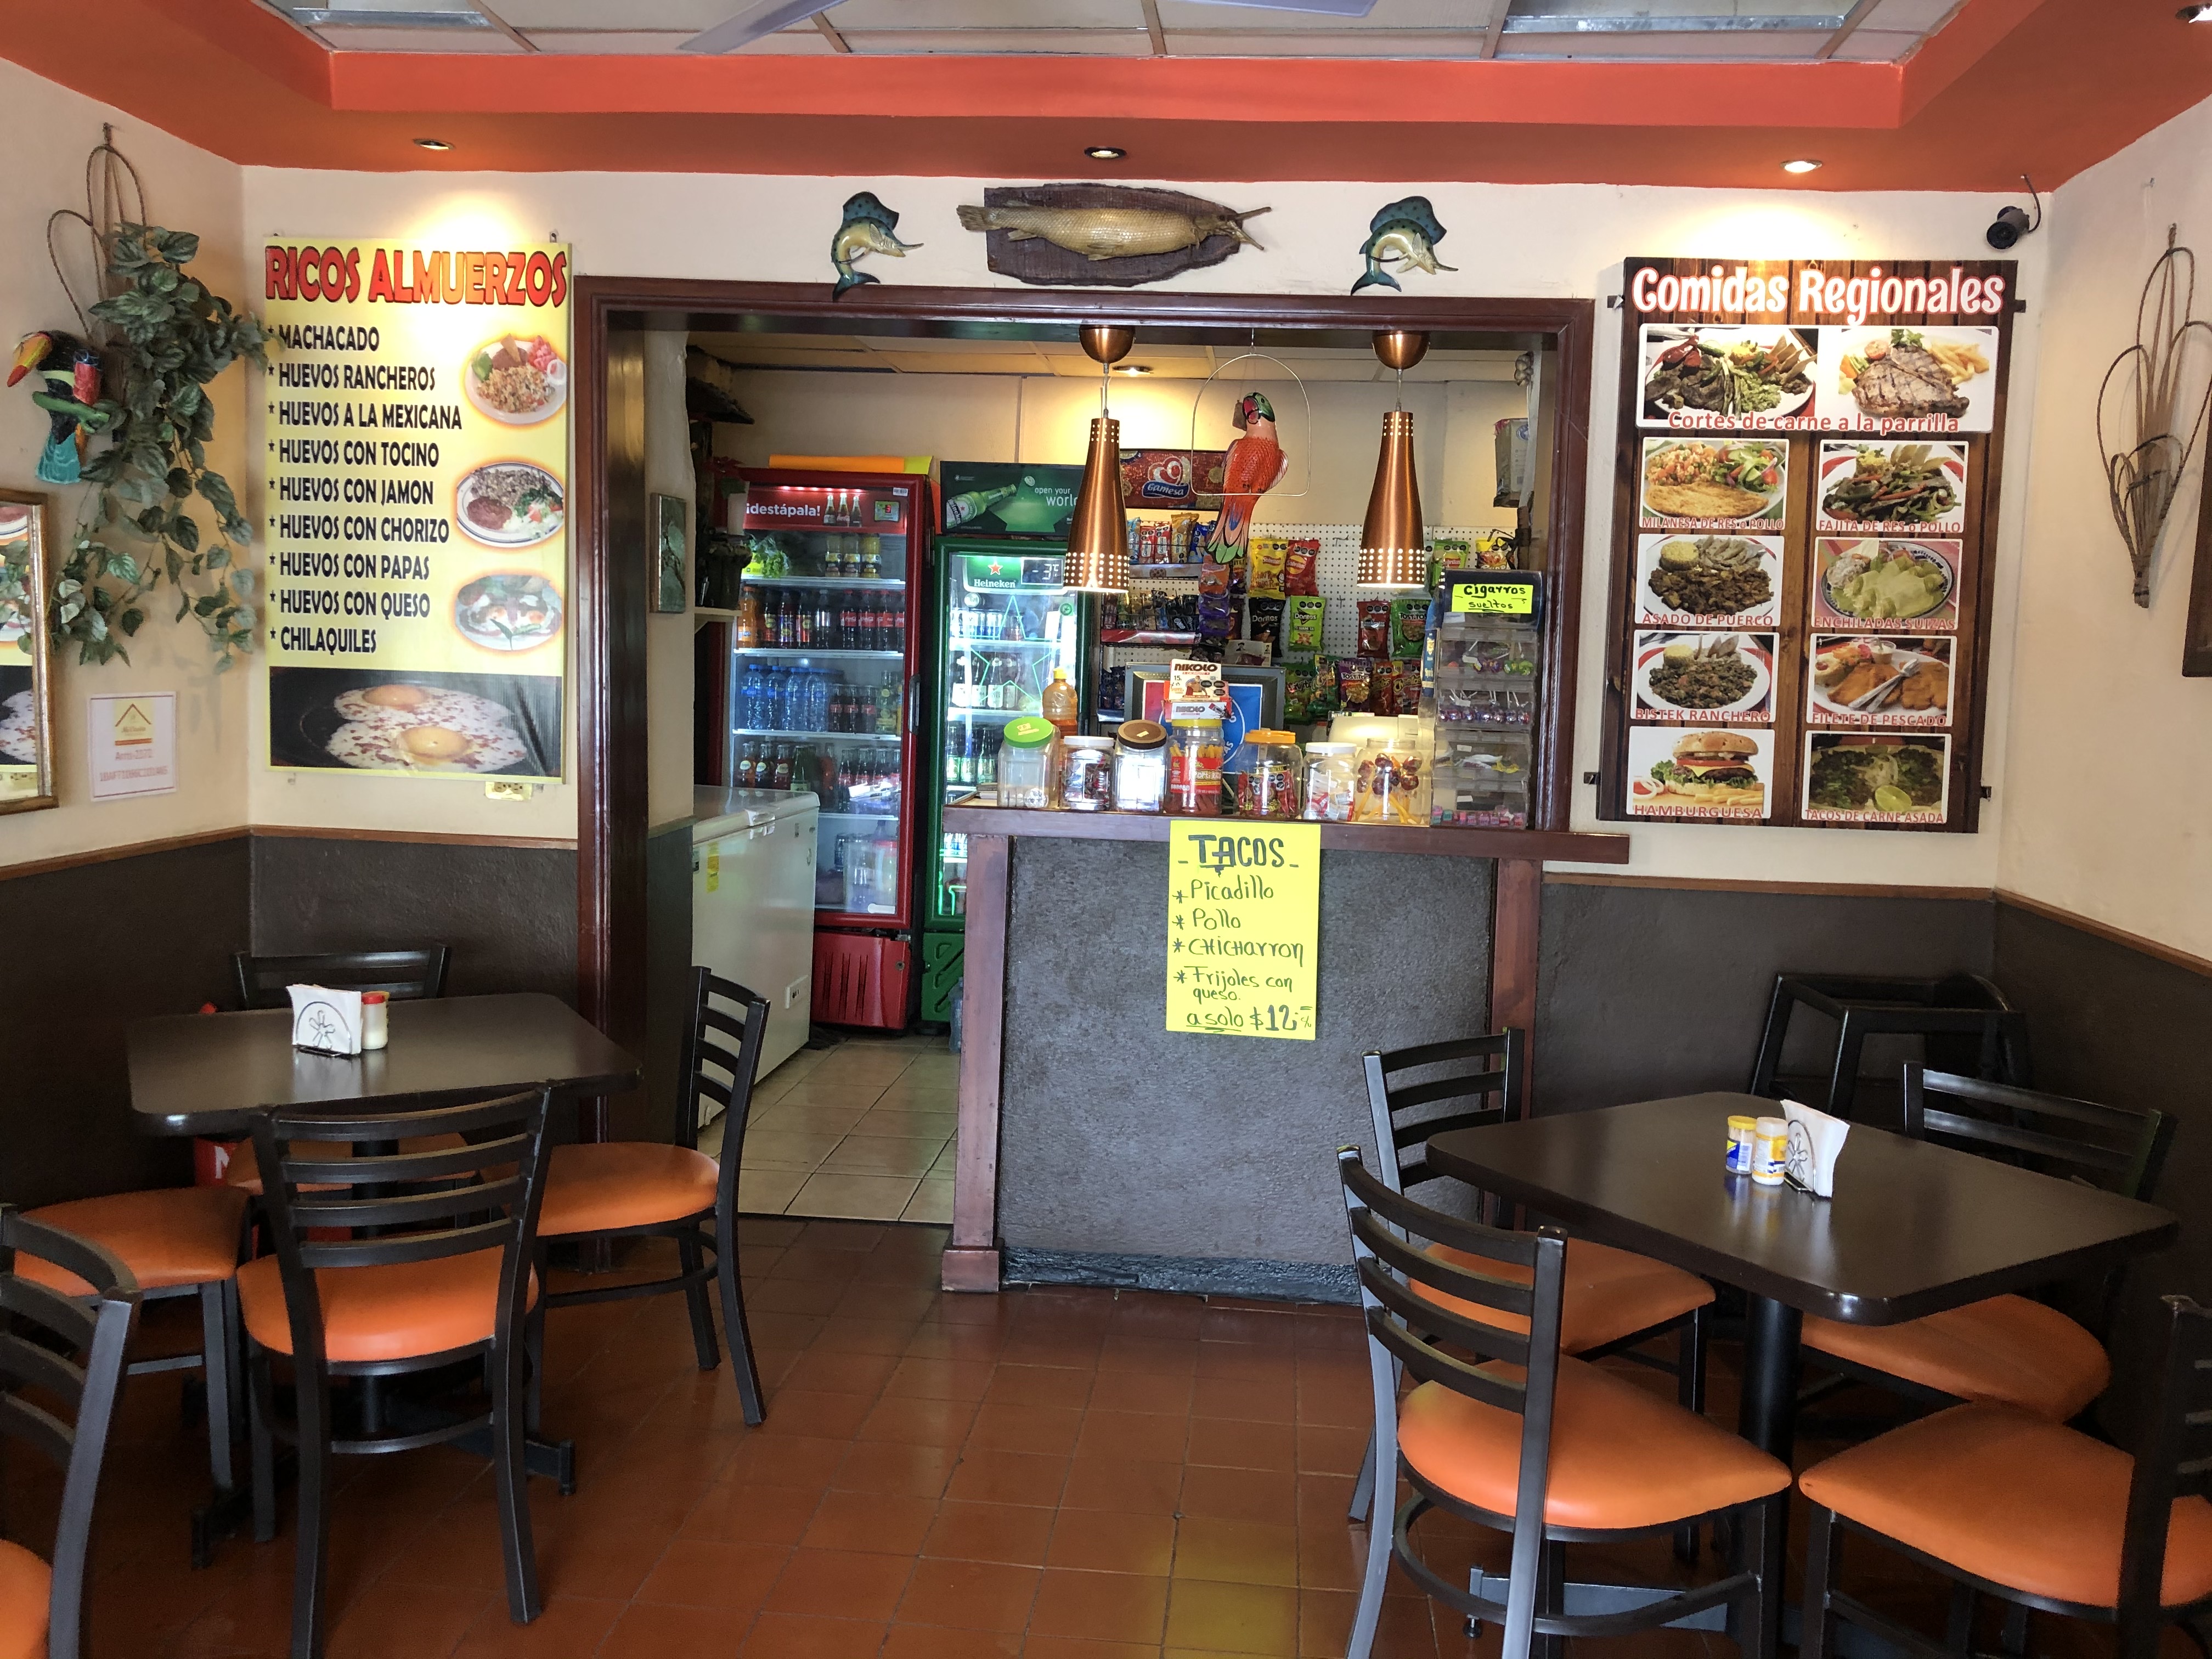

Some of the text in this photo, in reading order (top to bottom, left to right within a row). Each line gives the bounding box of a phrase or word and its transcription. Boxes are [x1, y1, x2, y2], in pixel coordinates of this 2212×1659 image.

[265, 246, 567, 307] RICOS ALMUERZOS
[1632, 264, 2005, 326] Comidas Regionales
[279, 325, 380, 351] MACHACADO
[279, 363, 435, 391] HUEVOS RANCHEROS
[279, 401, 462, 430] HUEVOS A LA MEXICANA
[1668, 411, 1959, 435] Cortes de carne a la parrilla
[279, 439, 439, 467] HUEVOS CON TOCINO
[280, 477, 433, 506] HUEVOS CON JAMON
[1147, 483, 1184, 495] Gamesa
[280, 515, 449, 543] HUEVOS CON CHORIZO
[1642, 517, 1697, 528] MILANESA
[1701, 517, 1714, 528] DE
[1718, 518, 1736, 529] RES
[1750, 518, 1783, 530] POLLO
[1819, 520, 1858, 531] FAJITA
[1863, 521, 1878, 531] DE
[1883, 521, 1905, 532] RES
[1920, 521, 1961, 533] POLLO
[280, 552, 430, 580] HUEVOS CON PAPAS
[974, 579, 1016, 588] Heineken
[280, 589, 430, 620] HUEVOS CON QUESO
[1252, 614, 1279, 623] Doritos
[1643, 613, 1773, 626] ASADO DE PUERCO
[1814, 617, 1955, 630] ENCHILADAS SUIZAS
[280, 627, 377, 655] CHILAQUILES
[1635, 709, 1771, 722] BISTEK RANCHERO
[1812, 713, 1946, 727] FILETE DE PESCADO
[1634, 805, 1762, 819] HAMBURGUESA
[1805, 809, 1944, 823] TACOS DE CARNE ASADA
[1188, 834, 1285, 868] TACOS
[1190, 874, 1274, 900] Picadillo
[1193, 908, 1241, 930] Pollo
[1184, 966, 1293, 992] Frijoles con
